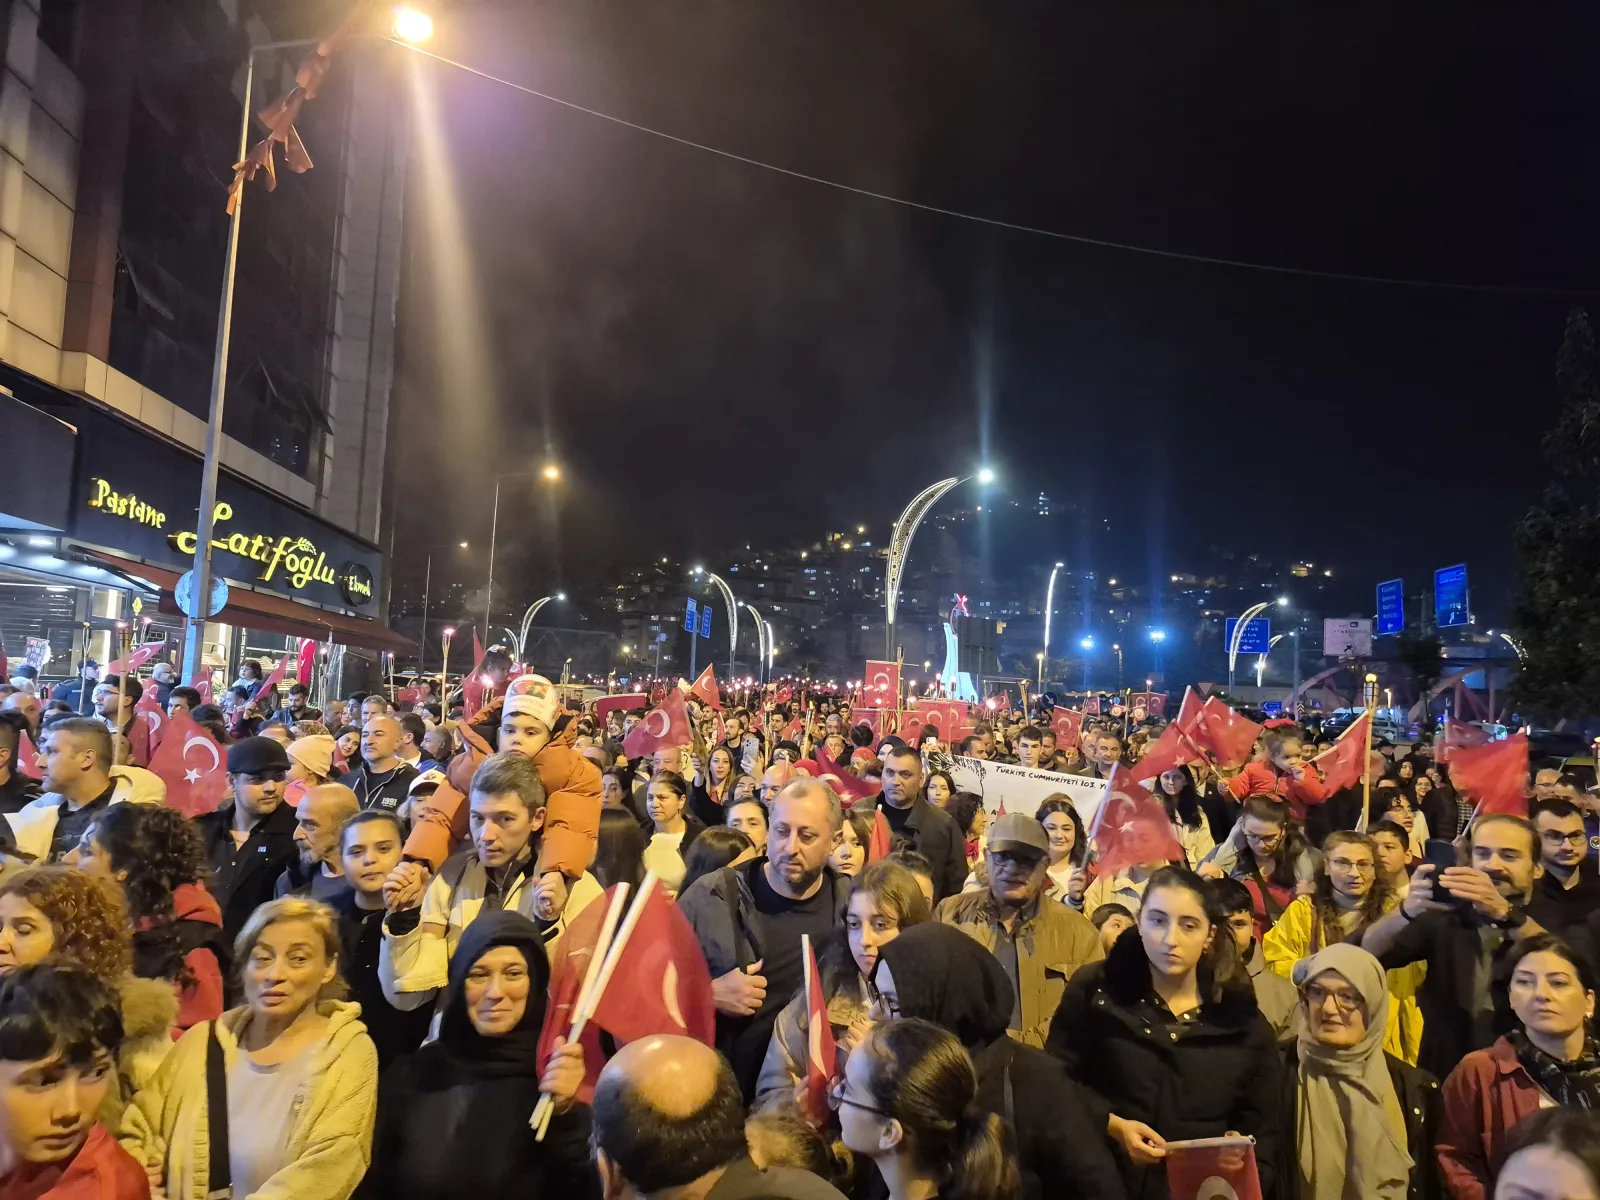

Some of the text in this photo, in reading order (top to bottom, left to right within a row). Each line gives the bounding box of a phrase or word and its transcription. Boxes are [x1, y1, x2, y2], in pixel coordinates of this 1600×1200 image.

[97, 479, 166, 529] Pastane
[349, 575, 371, 597] Ekmek
[995, 765, 1026, 778] TÜRKİYE
[1028, 772, 1079, 786] CUMHURİYETİ
[381, 797, 398, 807] 1991
